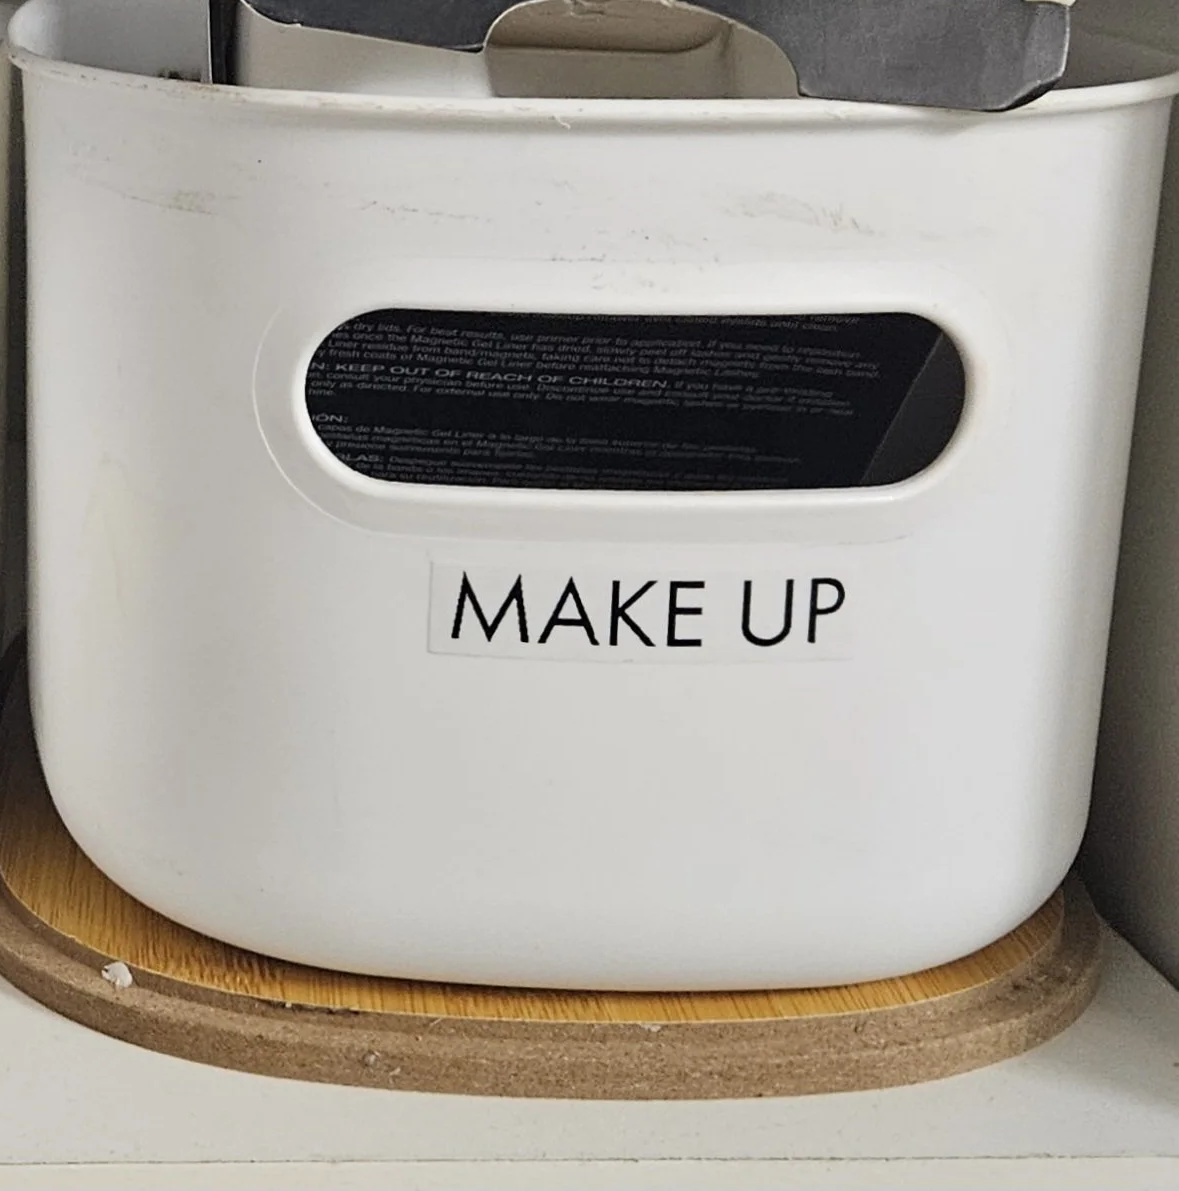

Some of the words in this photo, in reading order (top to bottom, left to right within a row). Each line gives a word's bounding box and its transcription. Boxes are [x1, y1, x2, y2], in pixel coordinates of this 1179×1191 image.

[352, 333, 383, 341] once
[388, 334, 407, 342] the
[410, 335, 468, 347] Magnetic
[472, 339, 493, 348] Gel
[496, 341, 527, 351] Liner
[532, 343, 554, 352] has
[596, 346, 635, 356] slowly
[407, 325, 426, 333] For
[431, 327, 457, 337] best
[510, 334, 533, 342] use
[537, 334, 578, 344] primer
[616, 337, 627, 346] to
[328, 340, 358, 349] Liner
[362, 342, 409, 352] residue
[412, 344, 441, 353] from
[542, 352, 579, 362] taking
[364, 351, 397, 360] coats
[400, 352, 413, 360] of
[417, 354, 473, 366] Magnetic
[477, 358, 498, 367] Gel
[536, 361, 575, 371] before
[326, 373, 370, 381] consult
[373, 374, 400, 384] your
[404, 377, 462, 387] physician
[335, 364, 385, 372] KEEP
[390, 366, 430, 375] OUT
[435, 368, 462, 378] OF
[466, 371, 532, 382] REACH
[537, 374, 565, 384] OF
[451, 571, 705, 647] MAKE
[741, 577, 846, 646] UP
